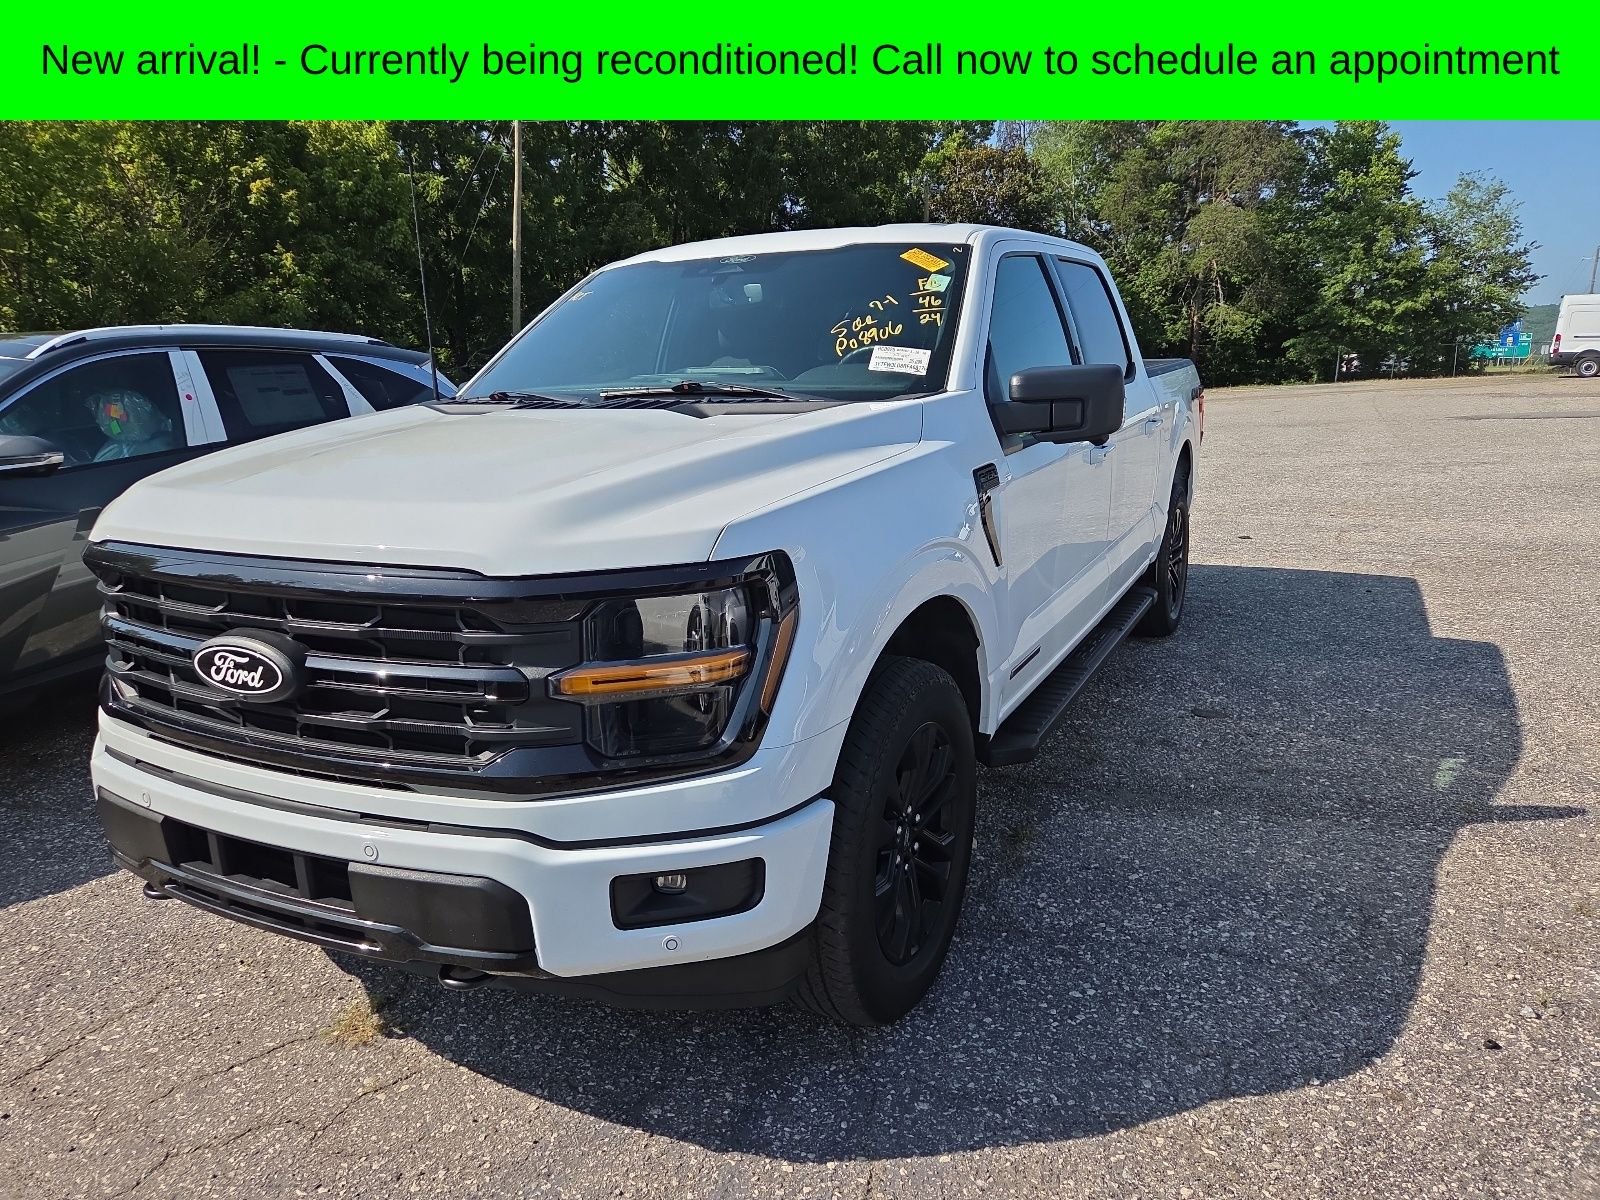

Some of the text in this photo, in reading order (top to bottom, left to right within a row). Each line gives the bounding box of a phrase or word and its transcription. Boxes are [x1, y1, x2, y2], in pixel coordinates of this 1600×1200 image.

[918, 295, 942, 308] 46
[919, 312, 941, 327] 24
[210, 651, 264, 688] Ford
